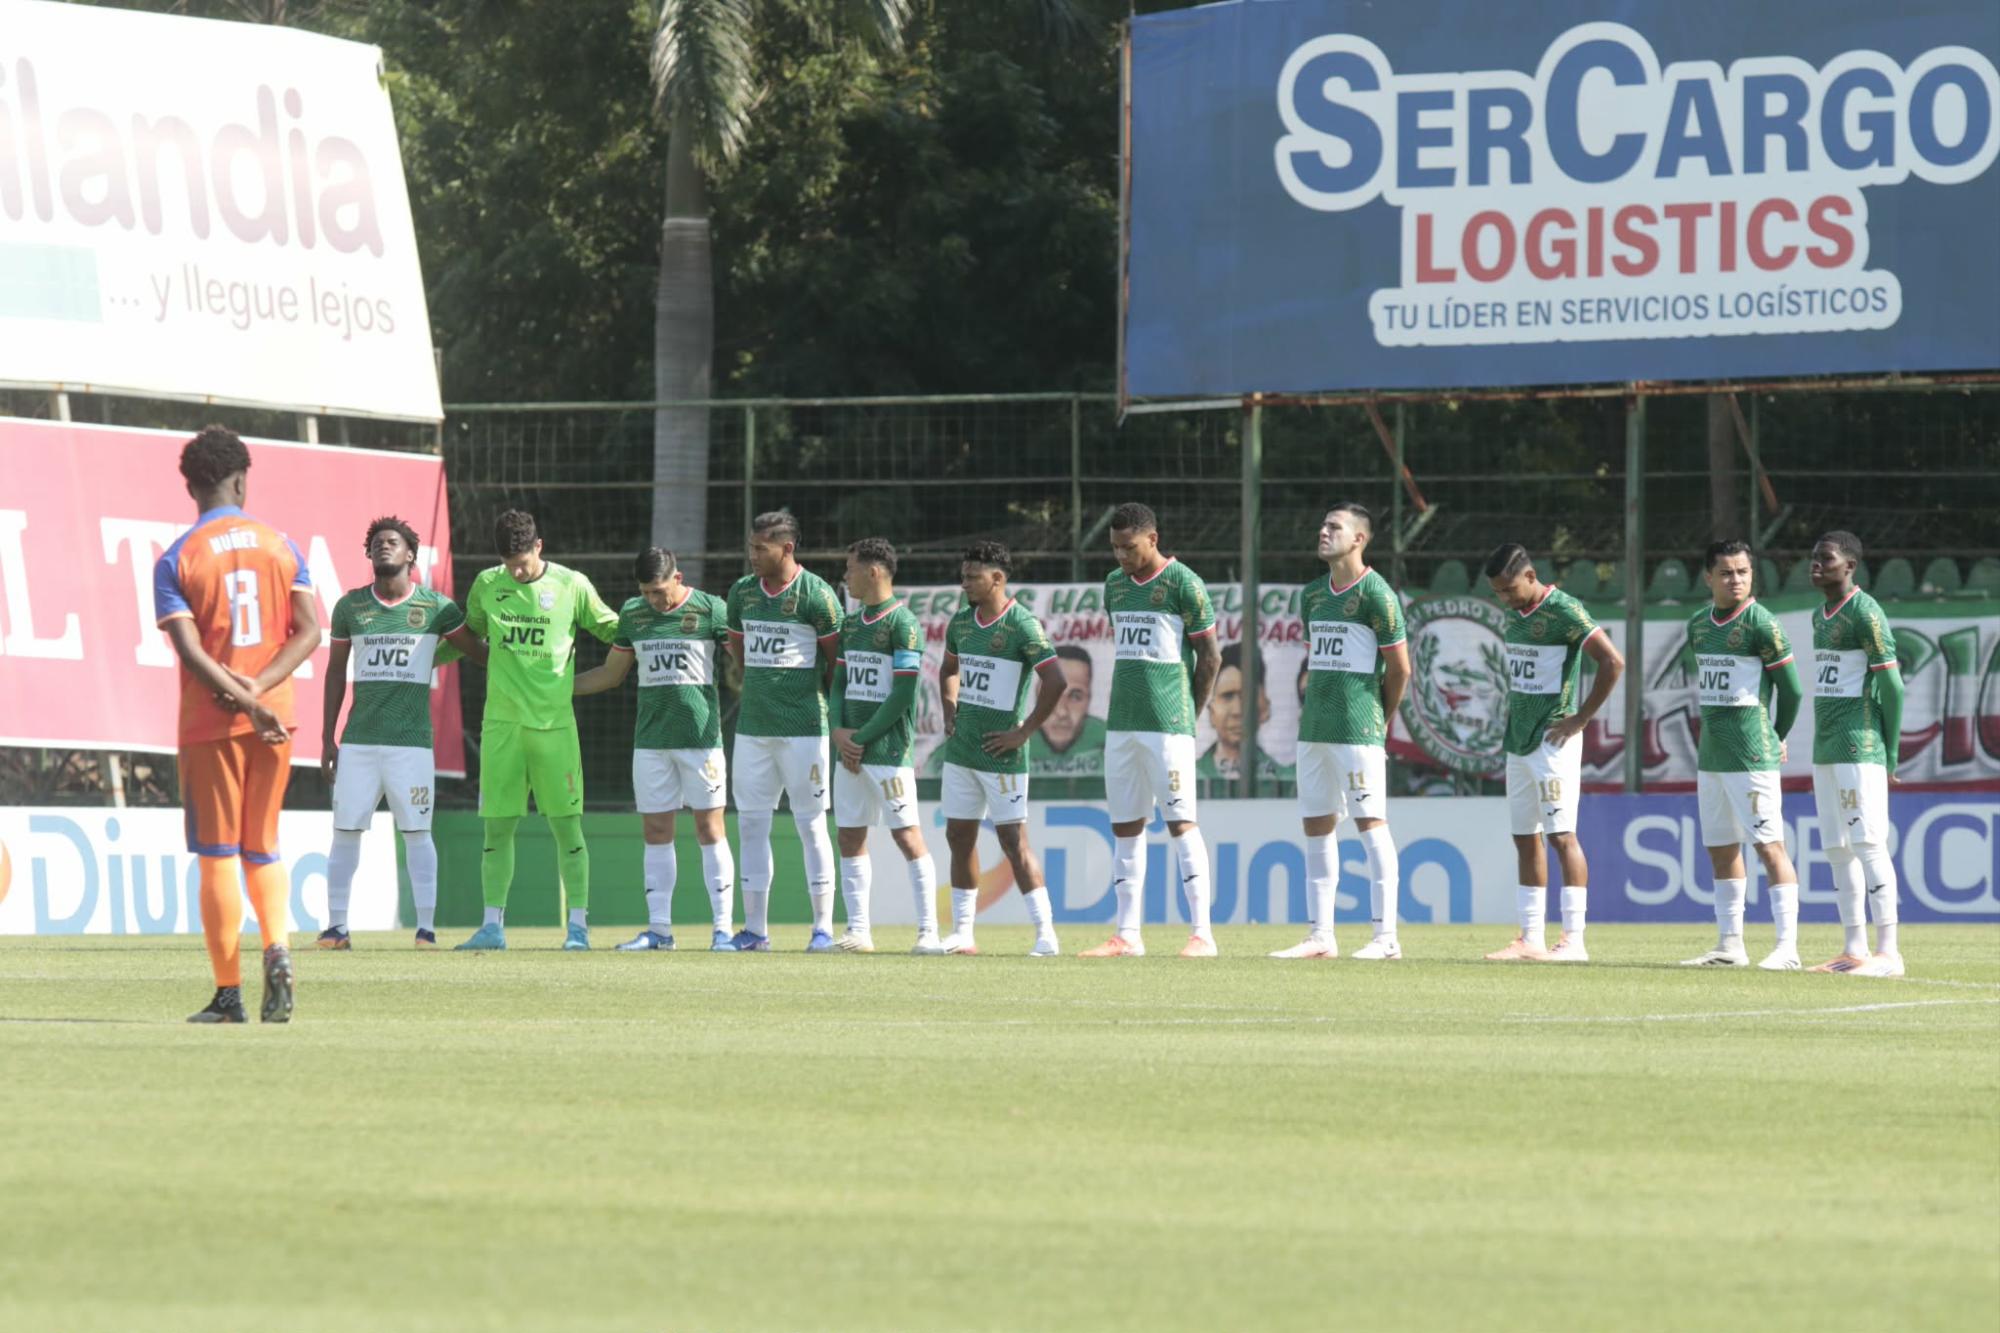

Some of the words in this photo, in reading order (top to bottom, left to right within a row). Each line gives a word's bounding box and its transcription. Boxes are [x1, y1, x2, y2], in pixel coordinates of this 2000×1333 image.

[1416, 194, 1856, 284] LOGISTICS
[150, 272, 171, 324] y
[183, 262, 299, 332] llegue
[310, 275, 395, 342] lejos
[1383, 304, 1418, 330] TU
[1427, 297, 1508, 329] LÍDER
[1517, 302, 1553, 326] EN
[1560, 294, 1710, 324] SERVICIOS
[1718, 284, 1888, 319] LOGÍSTICOS
[224, 569, 263, 648] 8
[502, 626, 546, 646] JVC
[749, 636, 787, 654] JVC
[1120, 627, 1152, 646] JVC
[1313, 637, 1344, 656] JVC
[367, 648, 410, 668] JVC
[648, 653, 689, 673] JVC
[1331, 660, 1351, 669] Bijao
[1700, 671, 1730, 691] JVC
[565, 772, 576, 794] 1
[809, 763, 821, 786] 4
[1347, 771, 1365, 791] 11
[409, 786, 430, 807] 22
[880, 776, 905, 801] 10
[1539, 779, 1562, 803] 19
[1747, 791, 1762, 815] 7
